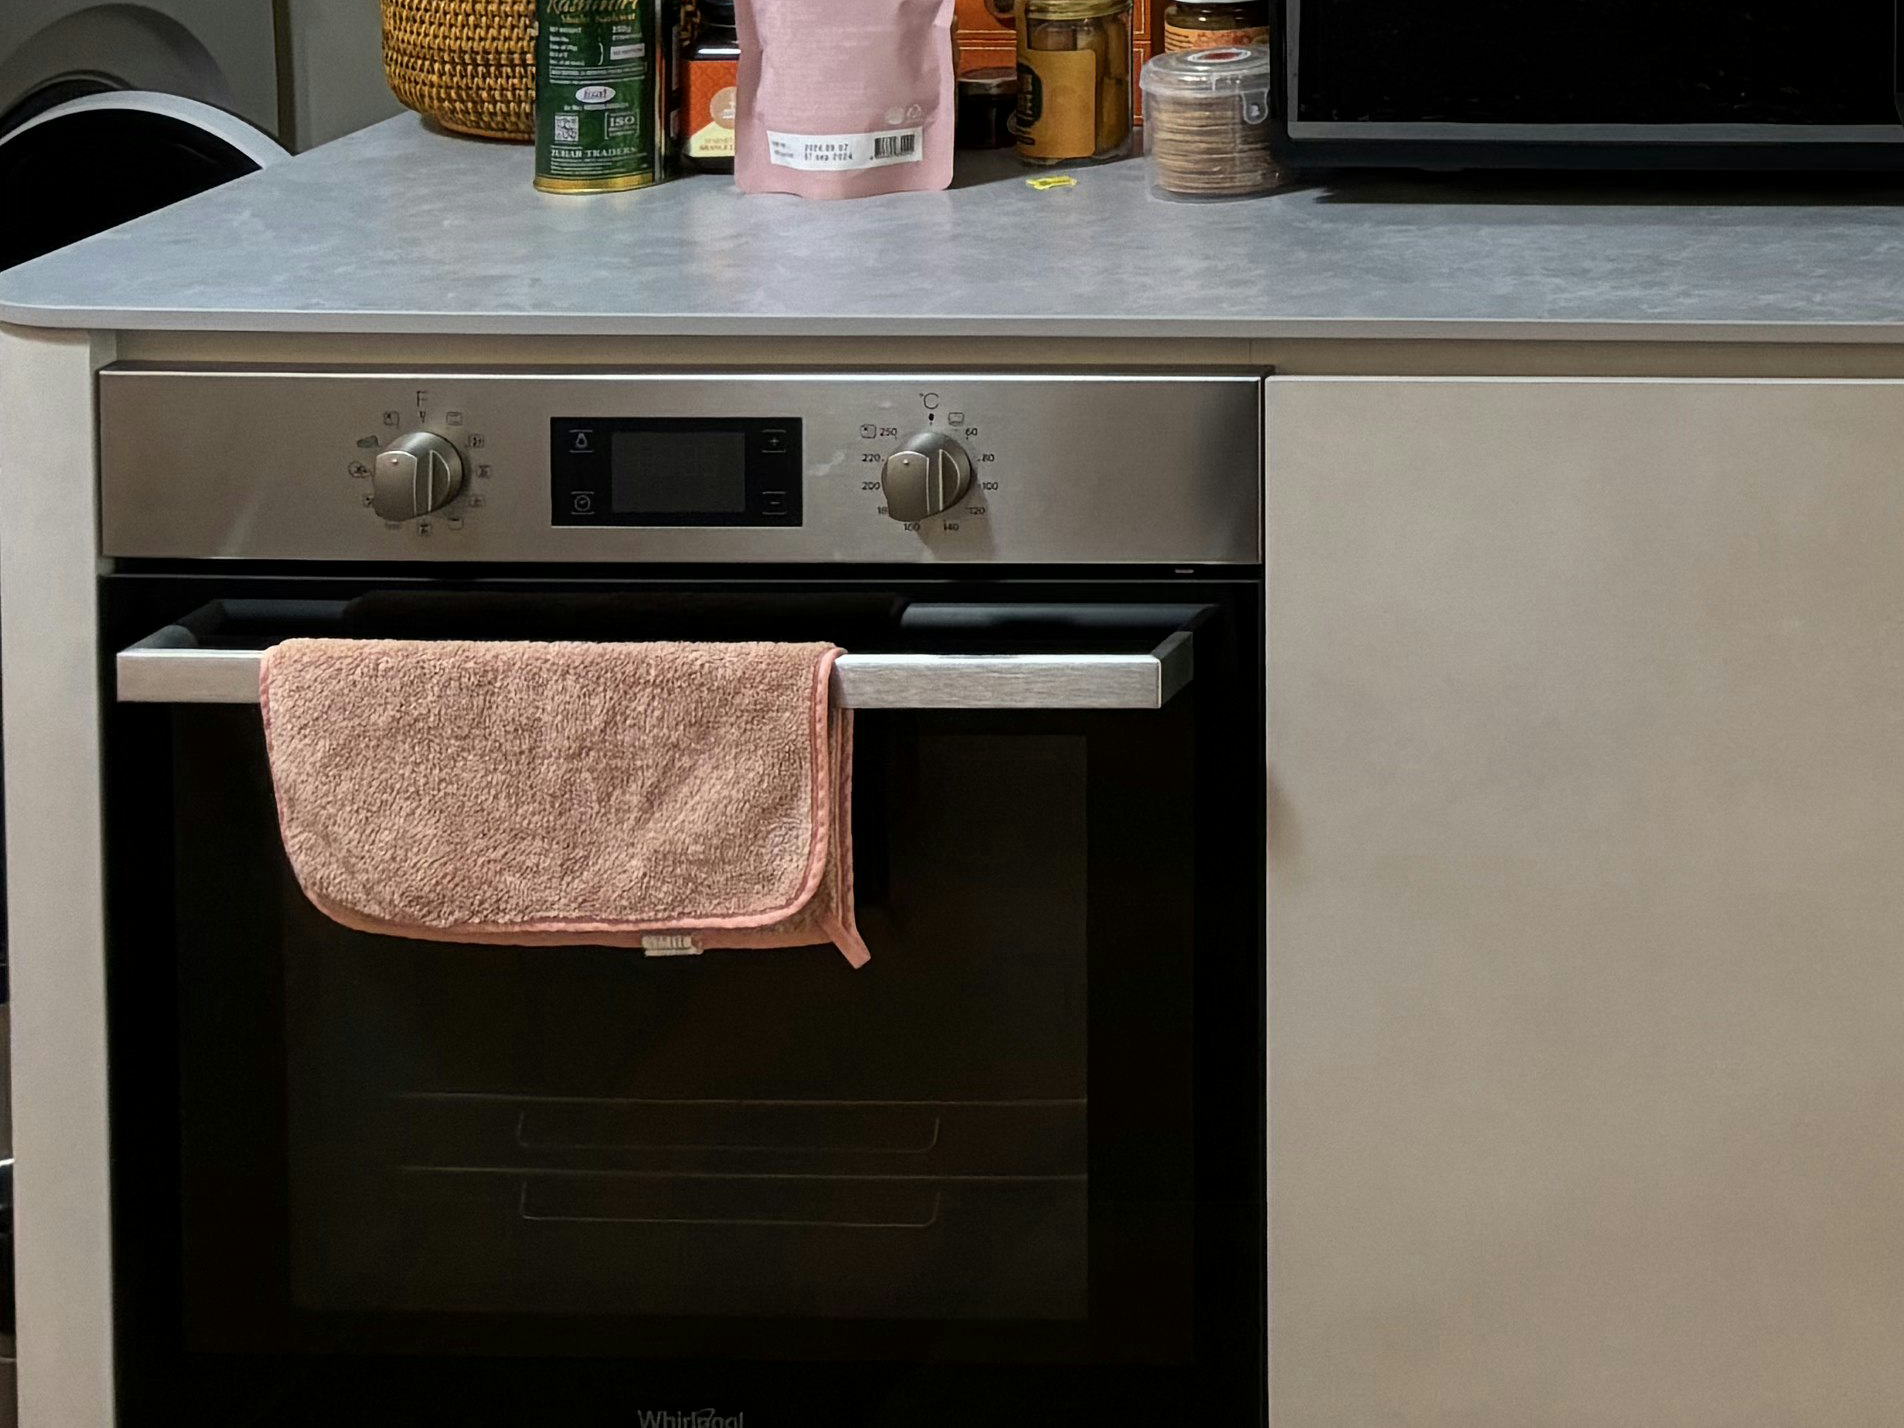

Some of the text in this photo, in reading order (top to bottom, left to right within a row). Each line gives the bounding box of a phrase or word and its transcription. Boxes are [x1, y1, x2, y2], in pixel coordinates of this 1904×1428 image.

[610, 115, 635, 127] ISO
[879, 427, 898, 437] 250
[965, 427, 978, 436] 60
[862, 453, 881, 462] 220
[982, 453, 995, 462] 80
[862, 481, 880, 490] 200
[983, 481, 999, 490] 100
[878, 506, 888, 515] 18
[968, 507, 985, 515] 120
[903, 523, 920, 531] 160
[943, 523, 959, 531] 140
